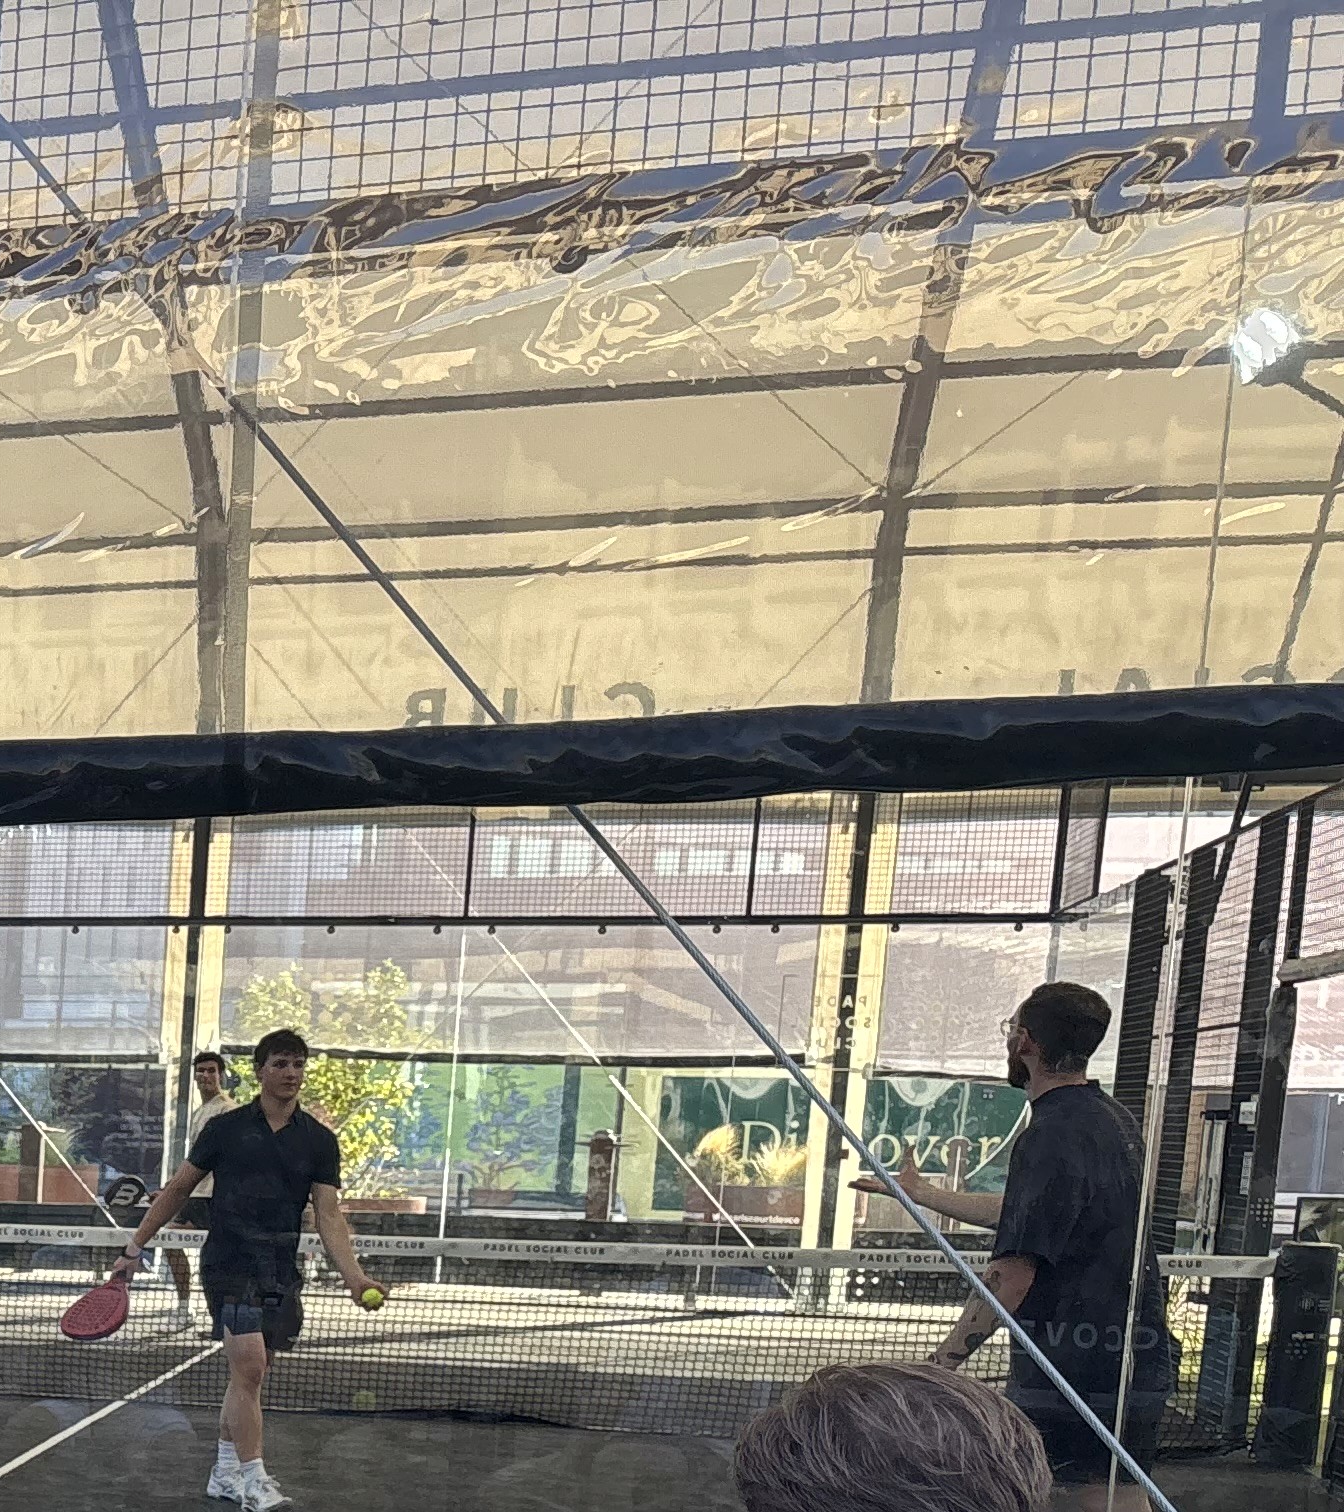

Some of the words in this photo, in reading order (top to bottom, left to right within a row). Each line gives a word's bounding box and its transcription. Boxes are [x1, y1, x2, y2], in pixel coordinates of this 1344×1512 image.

[13, 1228, 52, 1237] SOCIAL
[57, 1229, 85, 1239] CLUB
[395, 1241, 426, 1250] CLUB
[483, 1243, 520, 1252] PADEL
[526, 1244, 569, 1254] SOCIAL
[574, 1246, 606, 1255] CLUB
[666, 1249, 705, 1259] PADEL
[712, 1251, 756, 1260] SOCIAL
[762, 1252, 794, 1261] CLUB
[859, 1254, 900, 1264] PADEL
[1167, 1259, 1203, 1269] CLUB
